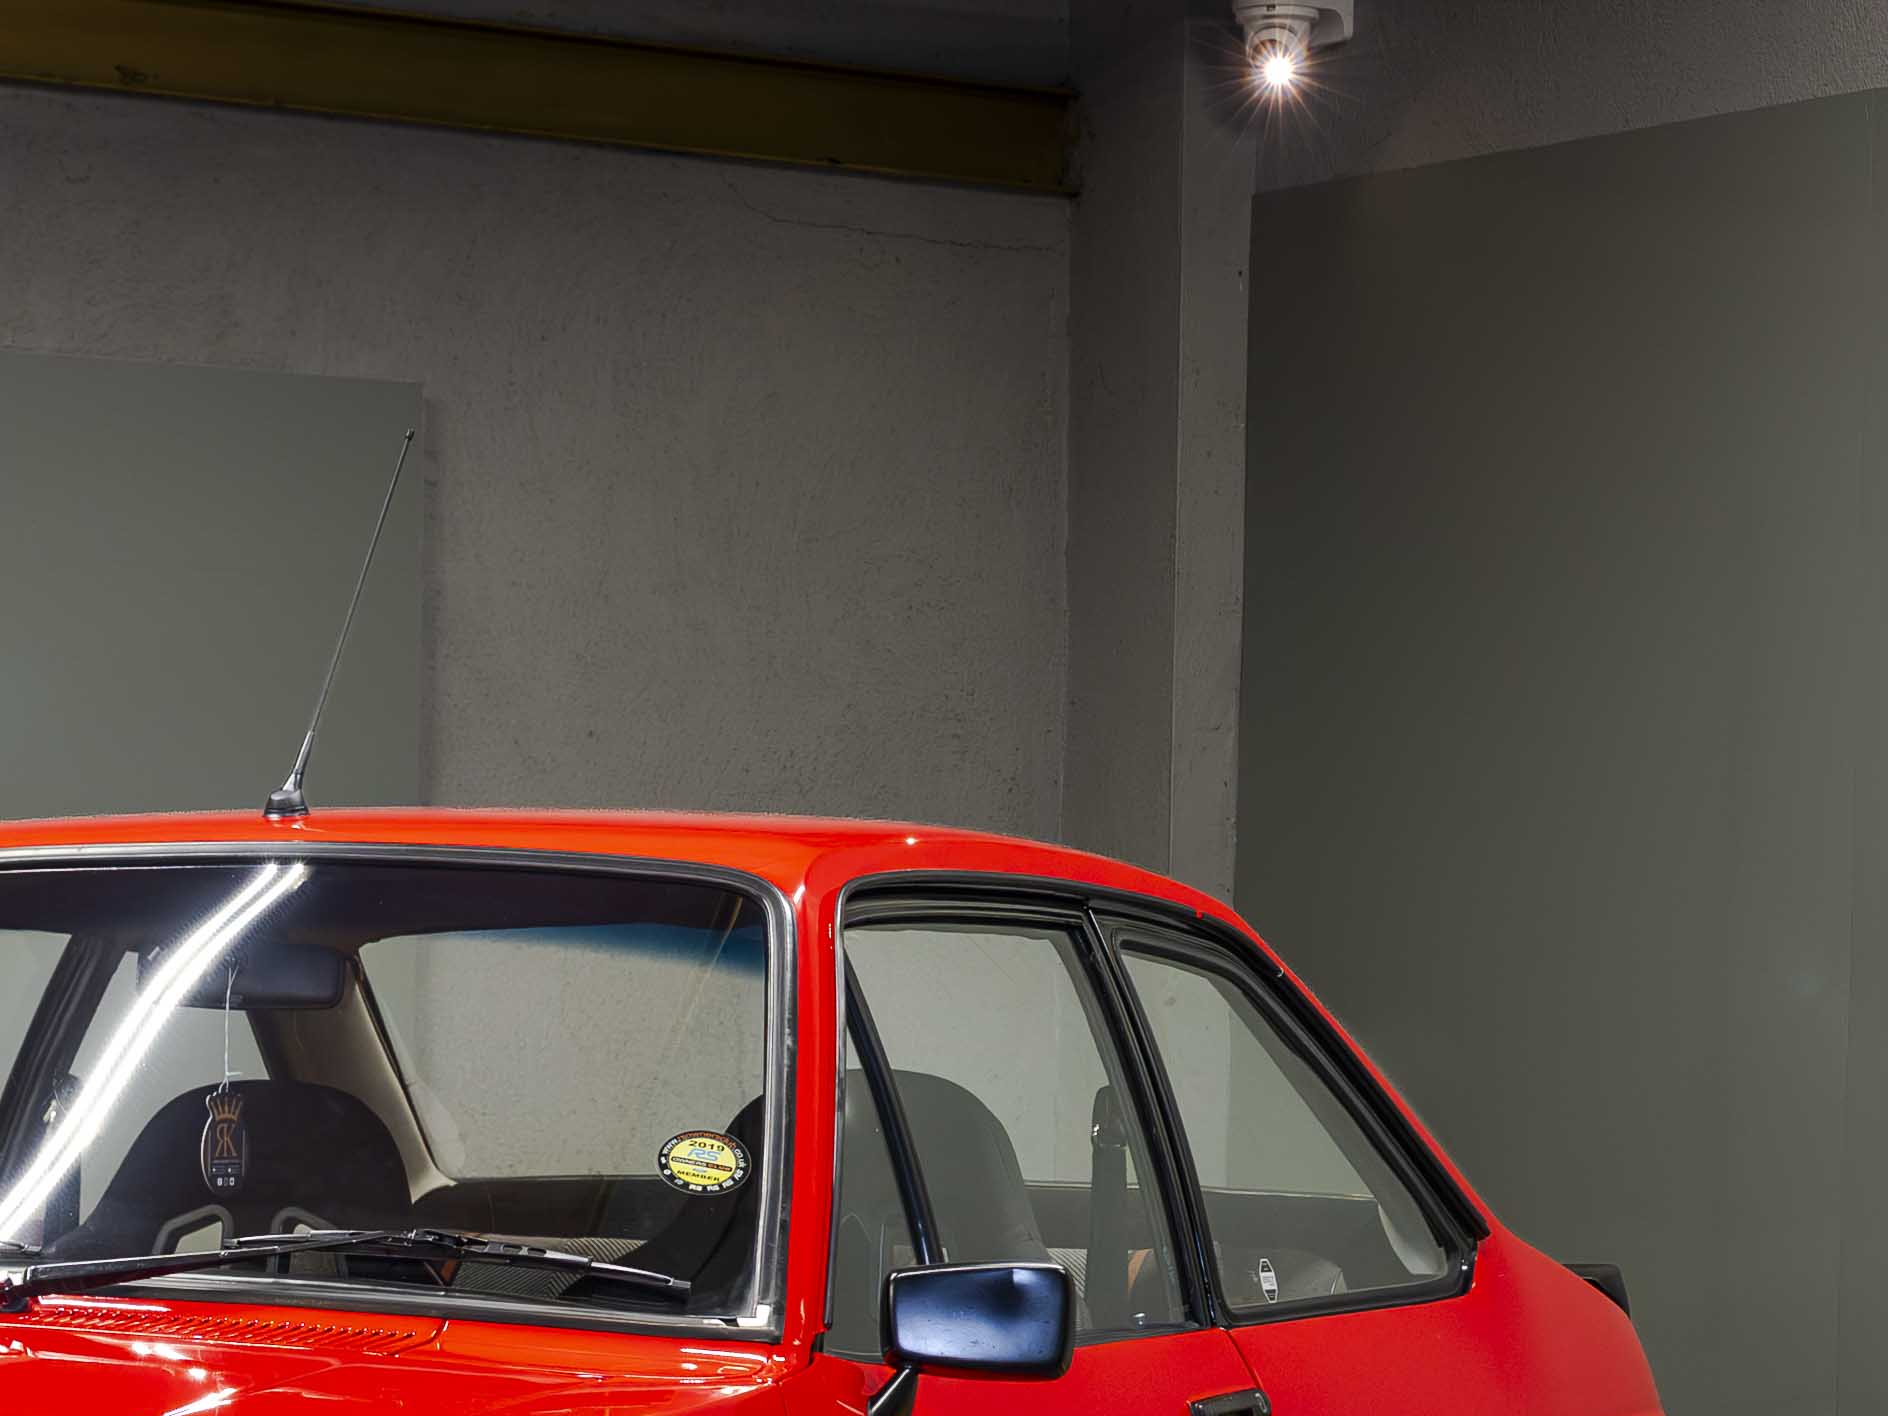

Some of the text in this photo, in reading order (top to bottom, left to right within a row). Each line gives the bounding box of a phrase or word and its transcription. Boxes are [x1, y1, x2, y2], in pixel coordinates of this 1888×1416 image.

[688, 1139, 725, 1152] 2019
[687, 1148, 721, 1162] RS
[676, 1169, 721, 1182] MEMBER
